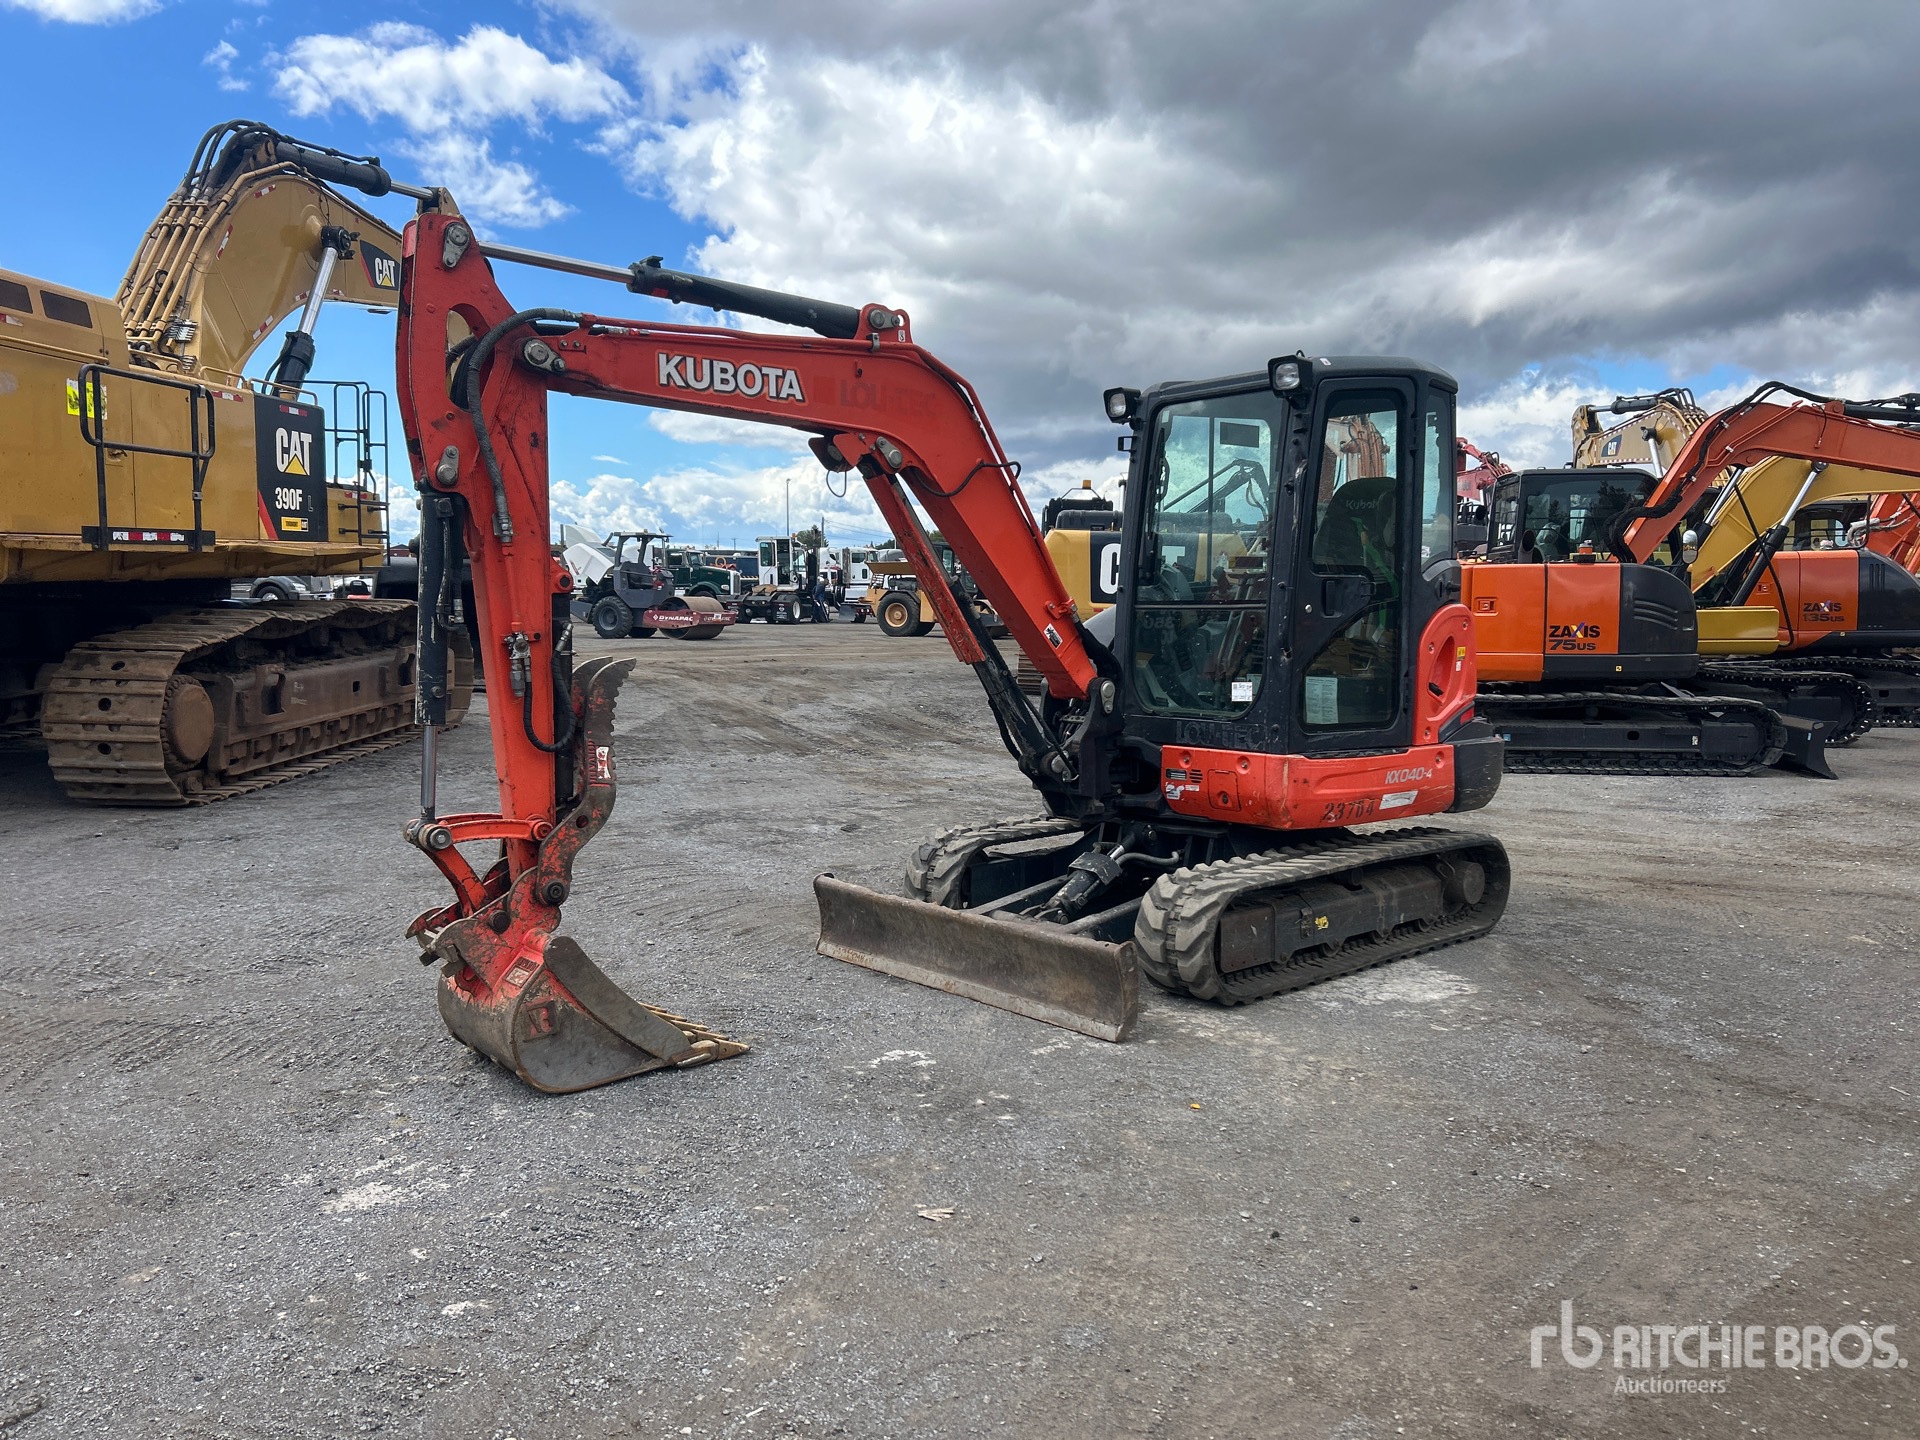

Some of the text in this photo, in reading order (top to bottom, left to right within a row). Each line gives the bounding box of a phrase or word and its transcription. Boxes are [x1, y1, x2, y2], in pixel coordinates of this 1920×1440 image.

[374, 257, 395, 287] CAT
[658, 352, 804, 402] KUBOTA
[276, 427, 312, 475] CAT
[275, 487, 303, 511] 390F
[1803, 600, 1842, 612] ZAXIS
[1549, 622, 1600, 638] ZAXIS
[1384, 768, 1433, 785] KX040-4
